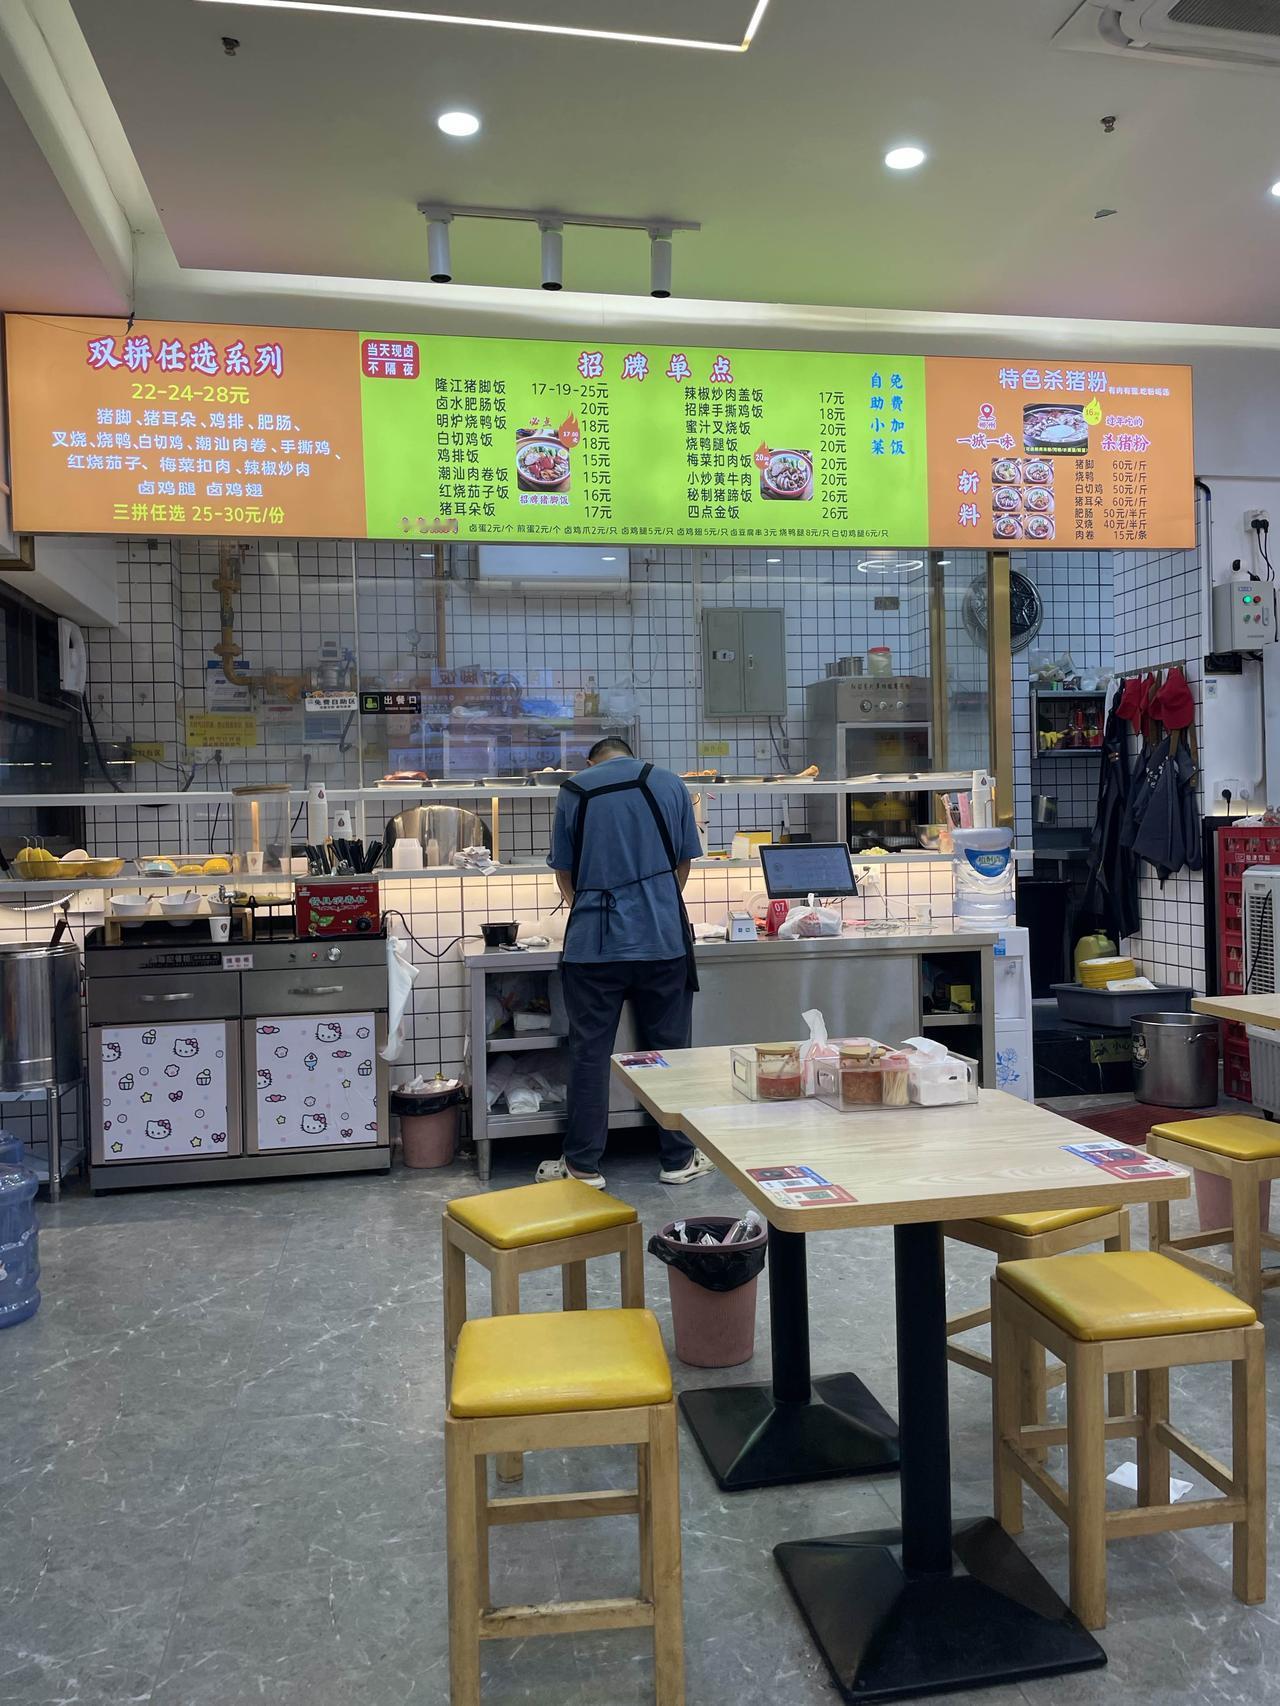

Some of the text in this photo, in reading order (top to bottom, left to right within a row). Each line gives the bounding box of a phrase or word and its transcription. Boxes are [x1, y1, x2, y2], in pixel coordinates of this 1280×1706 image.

[87, 335, 283, 377] 双拼任选系列
[366, 343, 415, 358] 当天现卤
[367, 361, 415, 376] 不隔夜
[577, 351, 733, 385] 招牌单点
[436, 378, 609, 398] 隆江猪脚饭 17-19-25元
[998, 367, 1108, 393] 特色杀猪粉
[132, 384, 249, 403] 22-24-28元
[684, 386, 844, 404] 辣椒炒肉盖饭 17元
[437, 395, 609, 415] 卤水肥肠饭 20元
[685, 403, 845, 421] 招牌手撕鸡饭 18元
[870, 372, 885, 454] 自助小菜
[890, 374, 905, 454] 免费加饭
[437, 414, 609, 433] 明炉烧鸭饭 18元
[686, 419, 846, 436] 蜜汁叉烧饭 20元
[438, 431, 610, 450] 白切鸡饭 18元
[686, 437, 846, 453] 烧鸭腿饭 20元
[957, 433, 1015, 450] 一城一味
[1102, 433, 1151, 452] 杀猪粉
[438, 448, 610, 467] 鸡排饭 15元
[687, 453, 847, 470] 梅菜扣肉饭 20元
[1076, 460, 1146, 470] 猪脚 60元/斤
[439, 466, 611, 484] 潮汕肉卷饭 15元
[688, 472, 847, 486] 小炒黄牛肉 20元
[1076, 471, 1146, 482] 烧鸭 50元/斤
[138, 480, 263, 497] 卤鸡腿 卤鸡翅
[439, 484, 611, 502] 红烧茄子饭 16元
[688, 488, 847, 503] 秘制猪蹄饭 26元
[1076, 484, 1147, 494] 白切鸡 50元/斤
[520, 495, 569, 504] 招牌猪脚饭
[958, 470, 981, 527] 斩料
[1075, 496, 1147, 507] 猪耳朵 60元/斤
[114, 504, 284, 523] 三拼任选 25-30元/份
[440, 502, 611, 519] 猪耳朵饭 17元
[689, 505, 848, 519] 四点金饭 26元
[1075, 508, 1146, 519] 肥肠 50元/半斤
[470, 524, 513, 532] 卤蛋2元/个
[1076, 519, 1146, 529] 叉烧 40元/半斤
[1076, 530, 1146, 540] 肉卷 15元/条
[384, 695, 417, 705] 出餐口
[774, 903, 785, 911] 07
